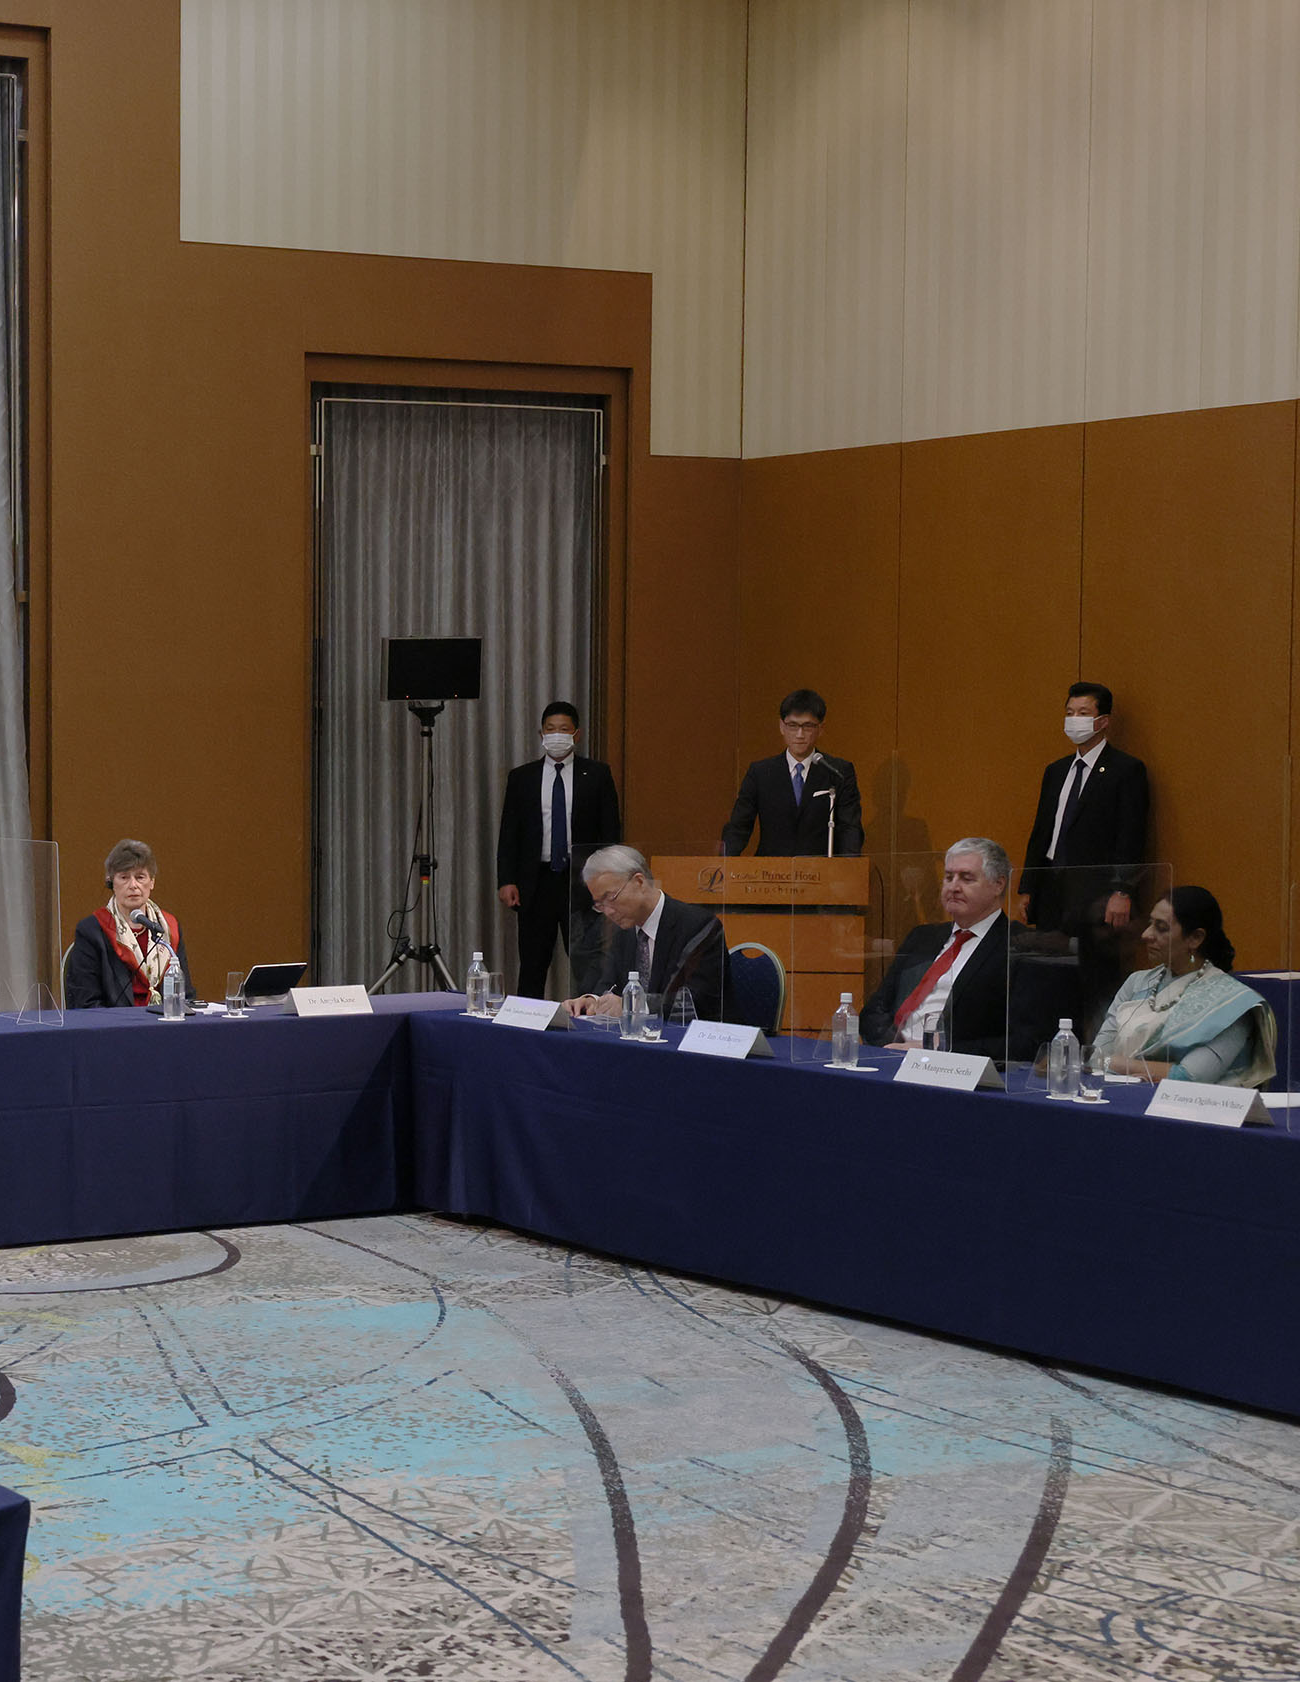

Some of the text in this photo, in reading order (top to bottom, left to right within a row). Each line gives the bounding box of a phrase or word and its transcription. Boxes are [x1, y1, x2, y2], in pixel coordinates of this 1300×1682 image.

[762, 870, 792, 881] Prince
[794, 871, 821, 881] Hotel
[911, 1061, 921, 1069] Dr.
